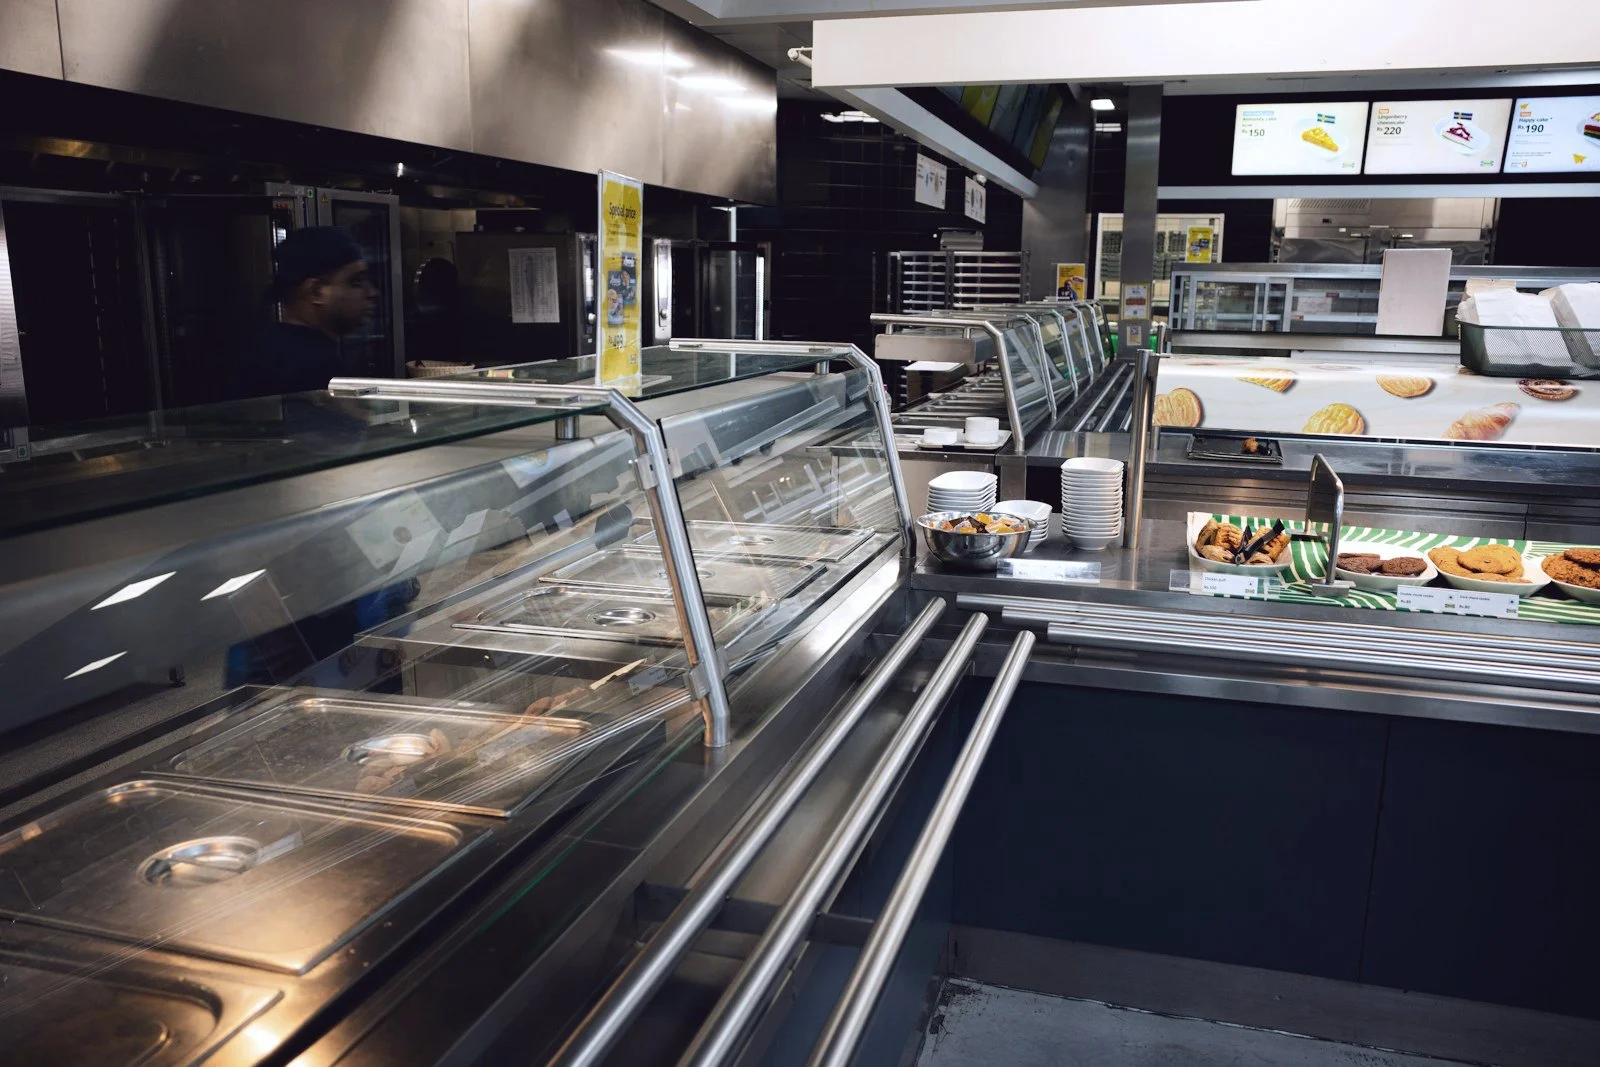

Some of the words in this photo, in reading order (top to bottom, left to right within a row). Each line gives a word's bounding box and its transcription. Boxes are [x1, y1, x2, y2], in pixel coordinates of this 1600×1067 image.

[1384, 127, 1402, 135] 220
[1526, 124, 1544, 133] 190
[609, 202, 624, 219] Special
[625, 206, 636, 221] price
